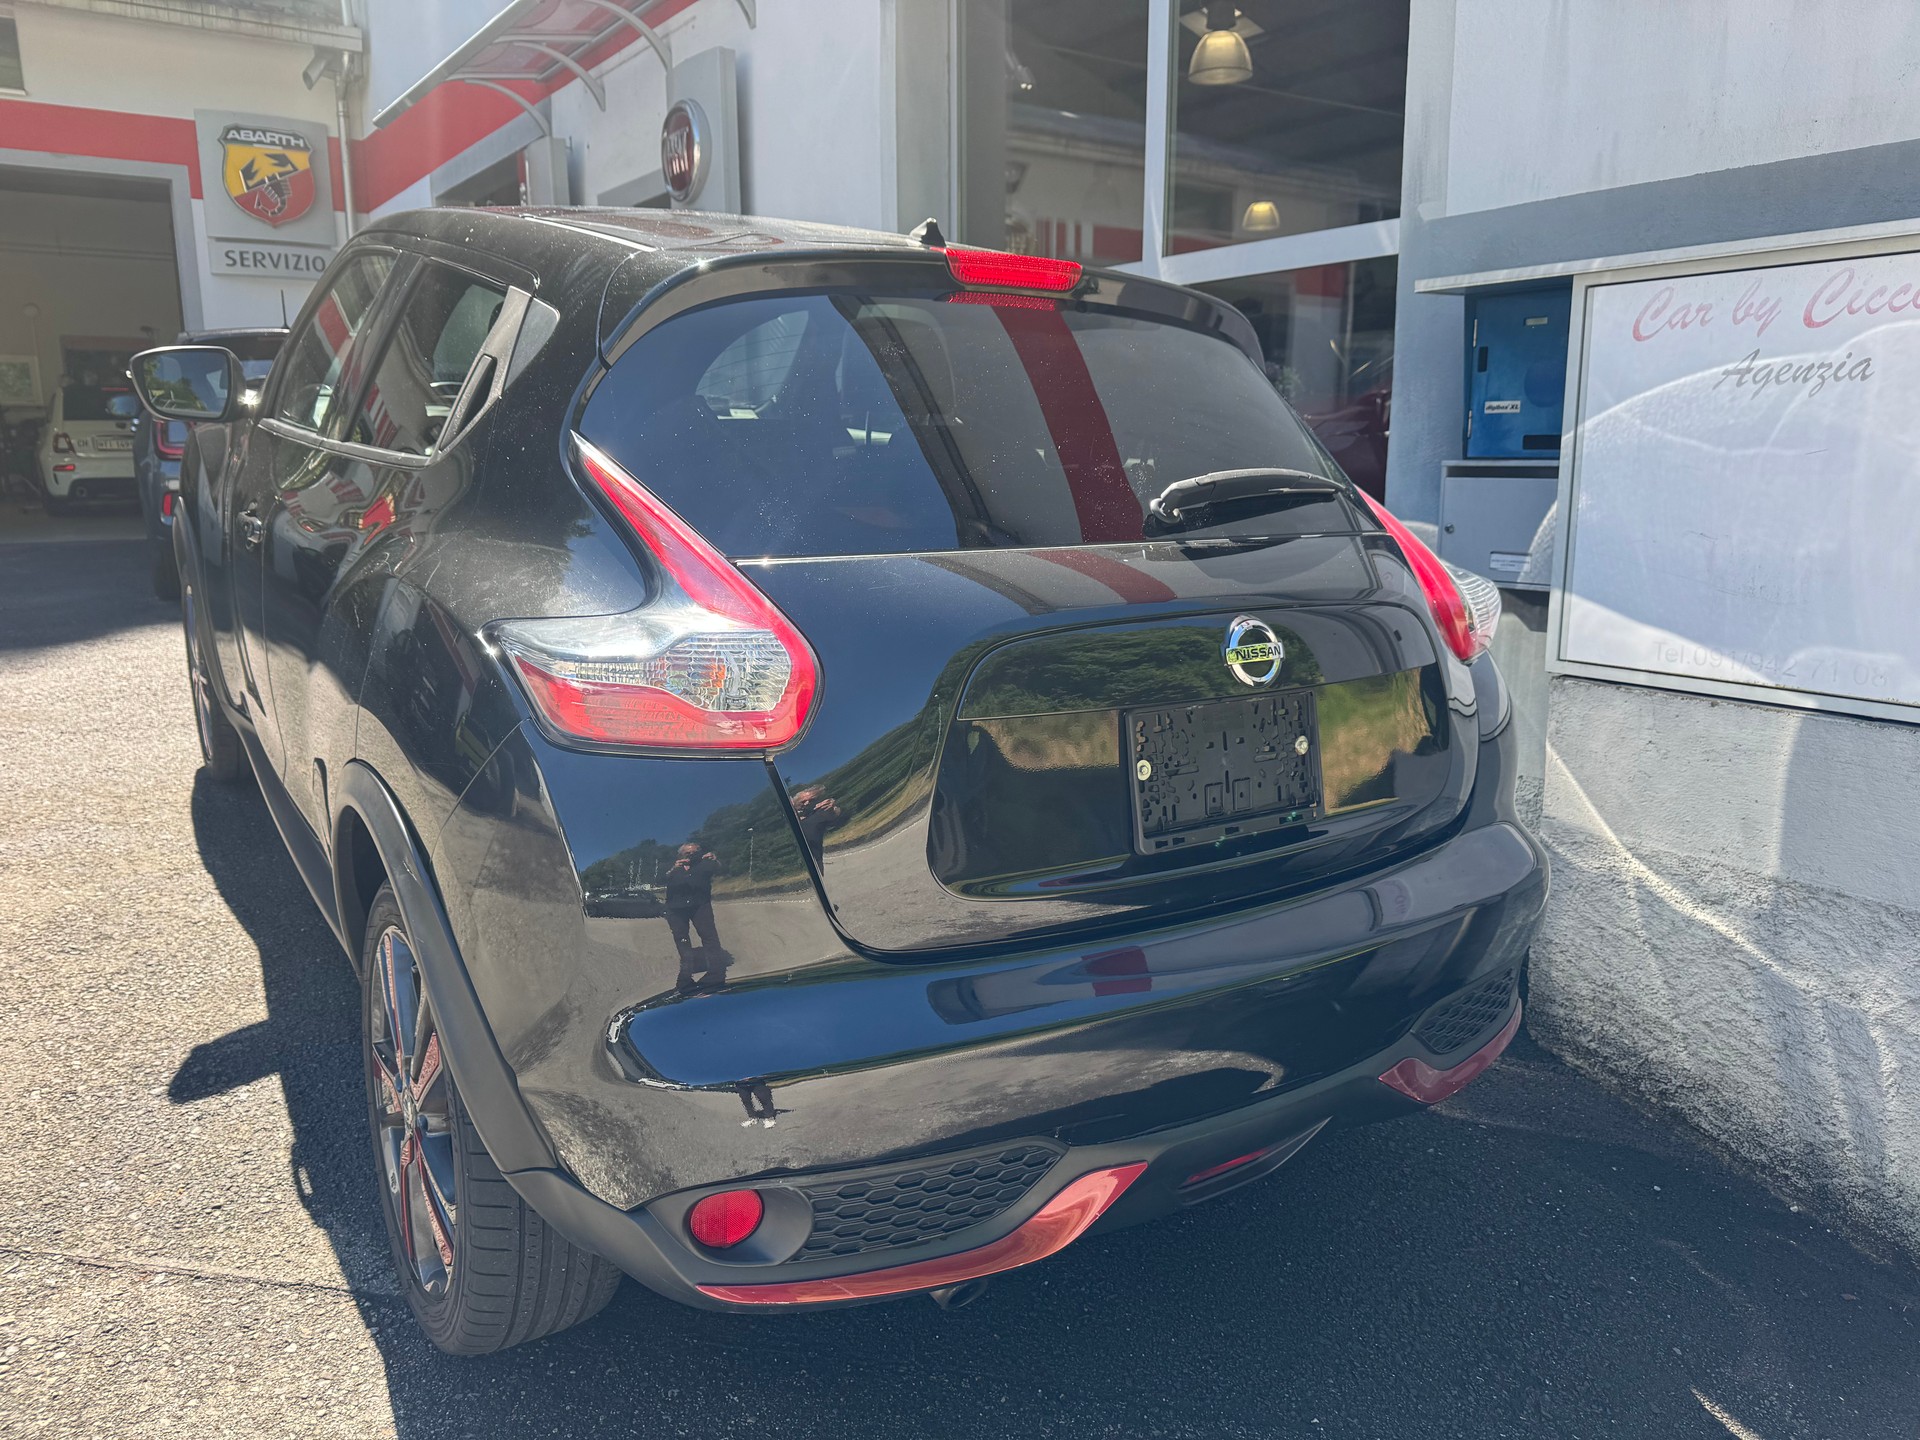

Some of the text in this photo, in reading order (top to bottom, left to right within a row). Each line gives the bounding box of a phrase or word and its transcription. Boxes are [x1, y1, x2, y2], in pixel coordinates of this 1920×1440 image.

[226, 129, 304, 147] ABARTH
[224, 249, 326, 273] SERVIZIO
[1632, 286, 1714, 342] Car
[1732, 277, 1782, 337] by
[1712, 348, 1875, 401] Agenzia
[1236, 645, 1280, 660] NISSAN
